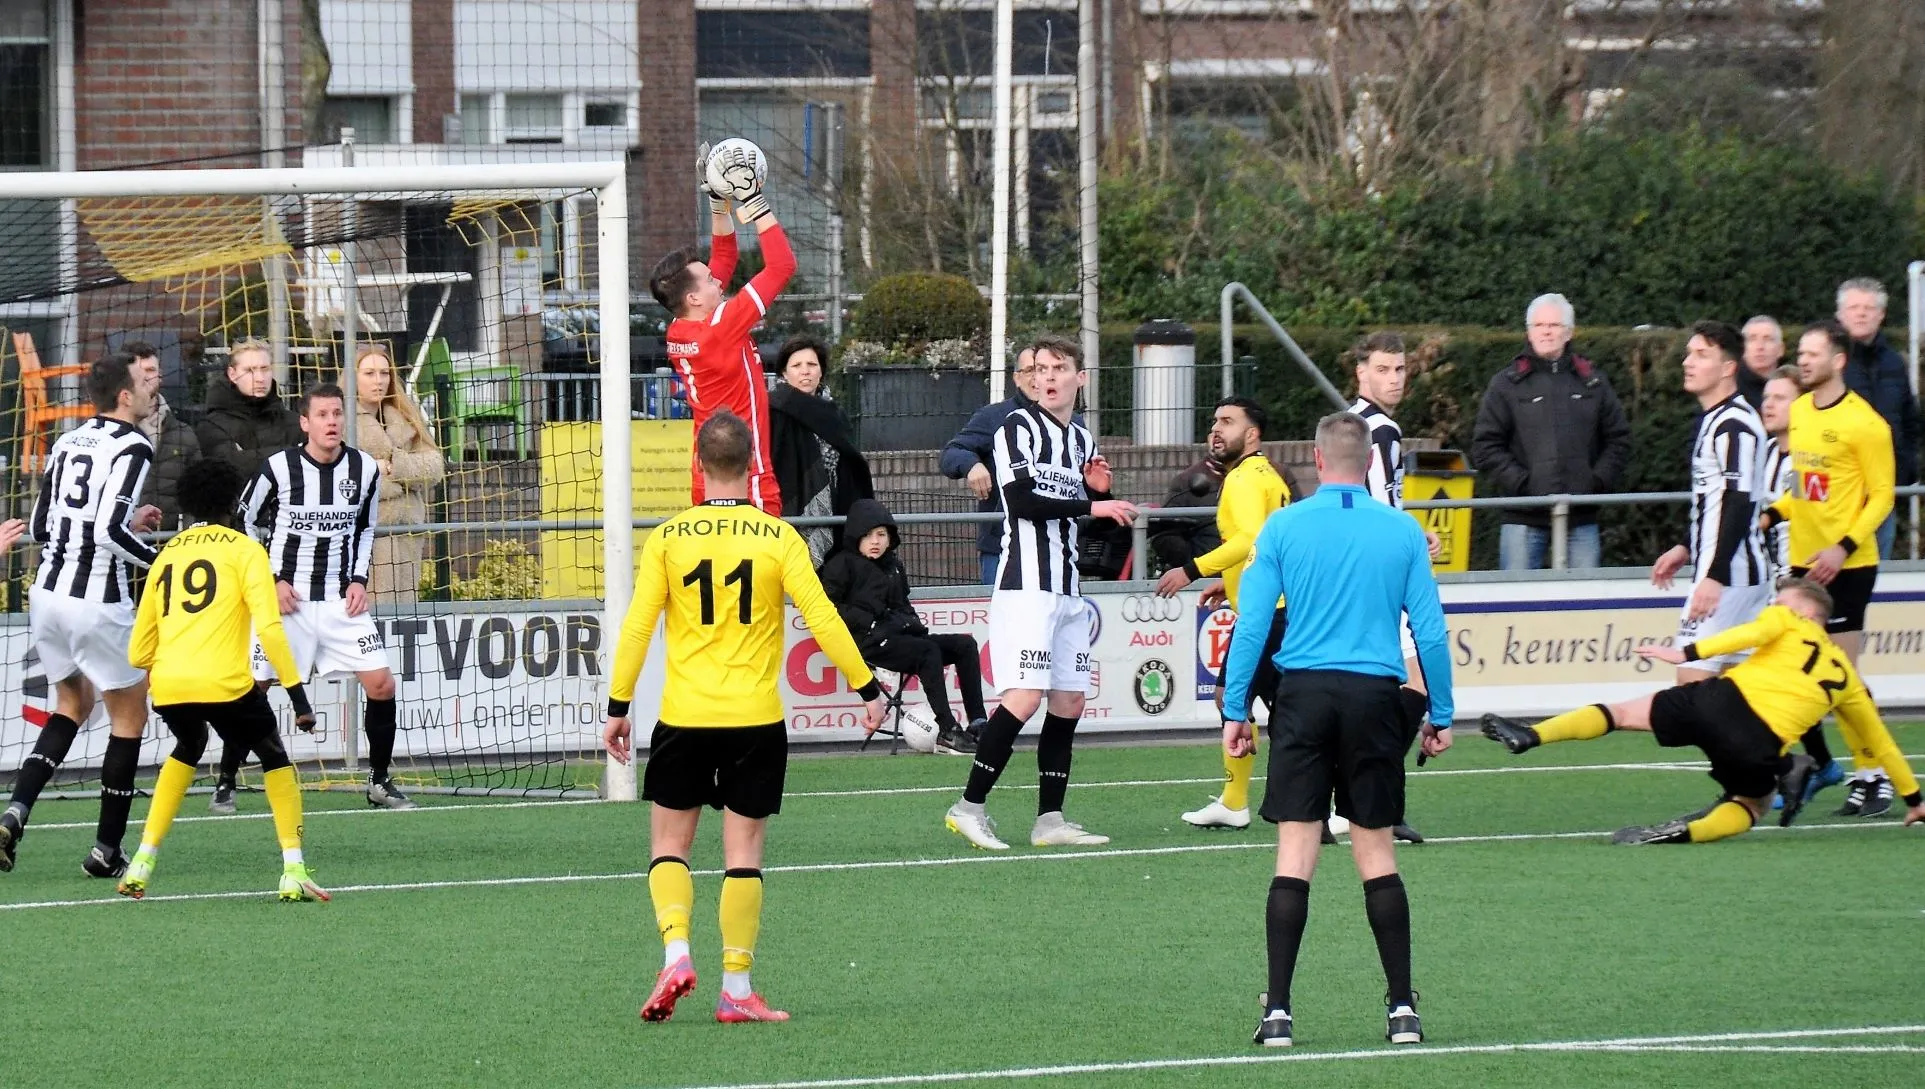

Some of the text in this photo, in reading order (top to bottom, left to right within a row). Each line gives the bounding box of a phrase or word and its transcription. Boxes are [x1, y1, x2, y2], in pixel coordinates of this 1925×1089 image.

[55, 451, 93, 509] 13
[663, 519, 781, 539] PROFINN
[167, 532, 237, 548] OFINN
[155, 559, 217, 618] 19
[682, 559, 753, 626] 11
[917, 609, 989, 627] BEDR
[1126, 630, 1174, 647] Audi
[378, 615, 602, 682] TVOOR
[1076, 652, 1090, 664] SY
[1075, 664, 1091, 672] BOU
[1197, 684, 1217, 695] KEU
[1083, 706, 1113, 718] AT
